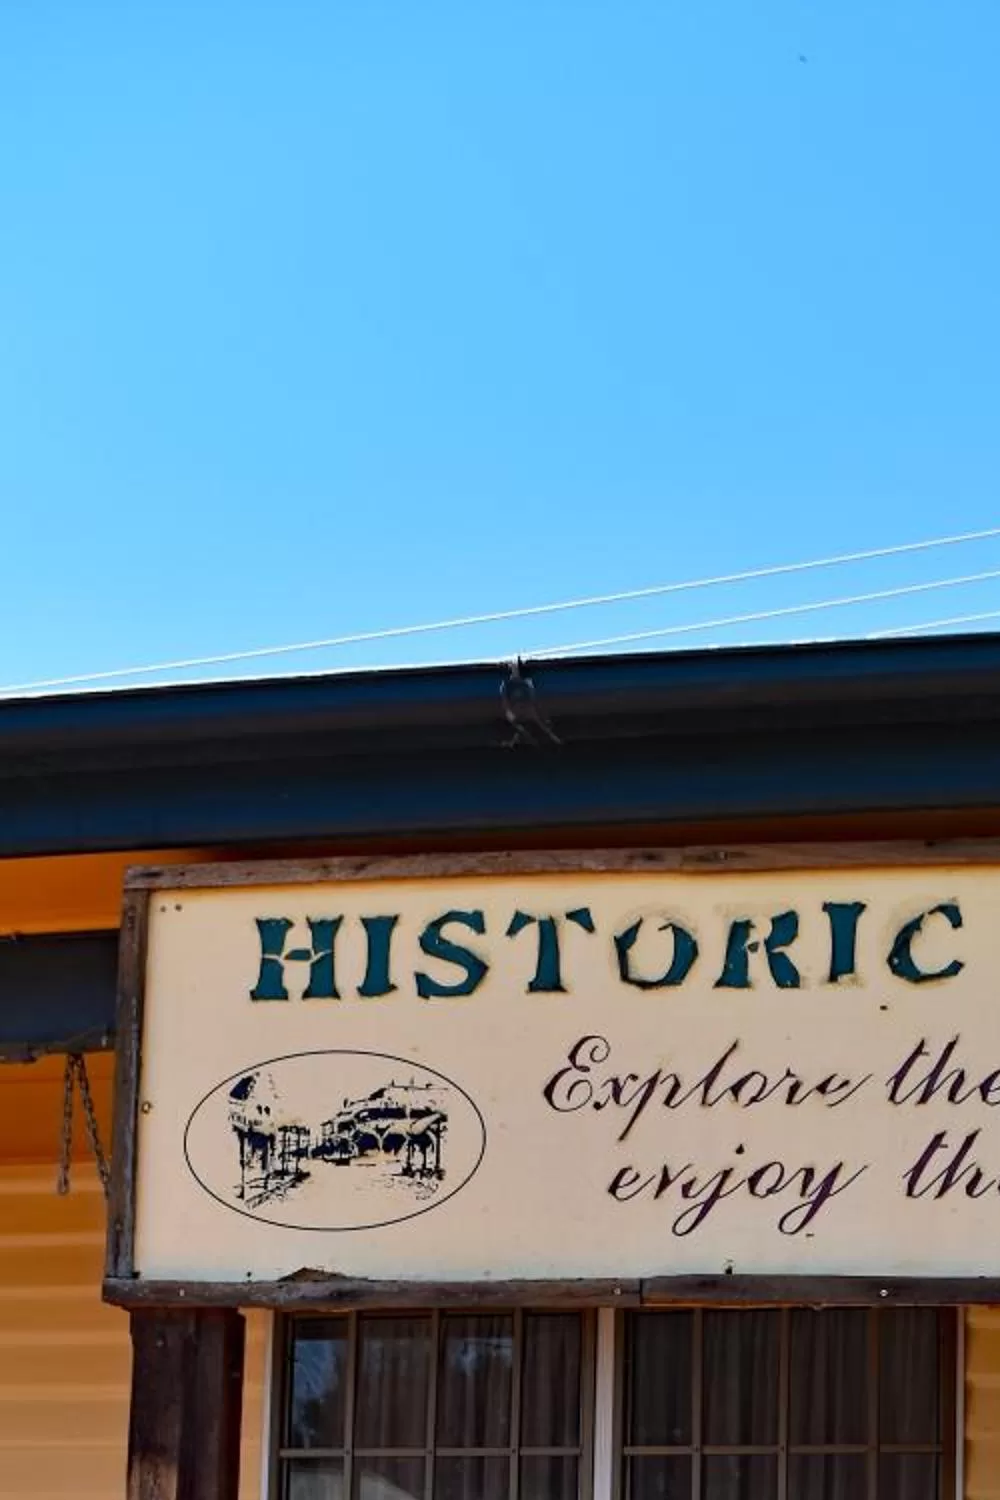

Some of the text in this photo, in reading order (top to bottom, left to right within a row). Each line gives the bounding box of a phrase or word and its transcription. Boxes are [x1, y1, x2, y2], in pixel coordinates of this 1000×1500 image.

[248, 896, 967, 1004] HISTORIC
[542, 1034, 875, 1143] Explore
[606, 1142, 870, 1238] enjoy
